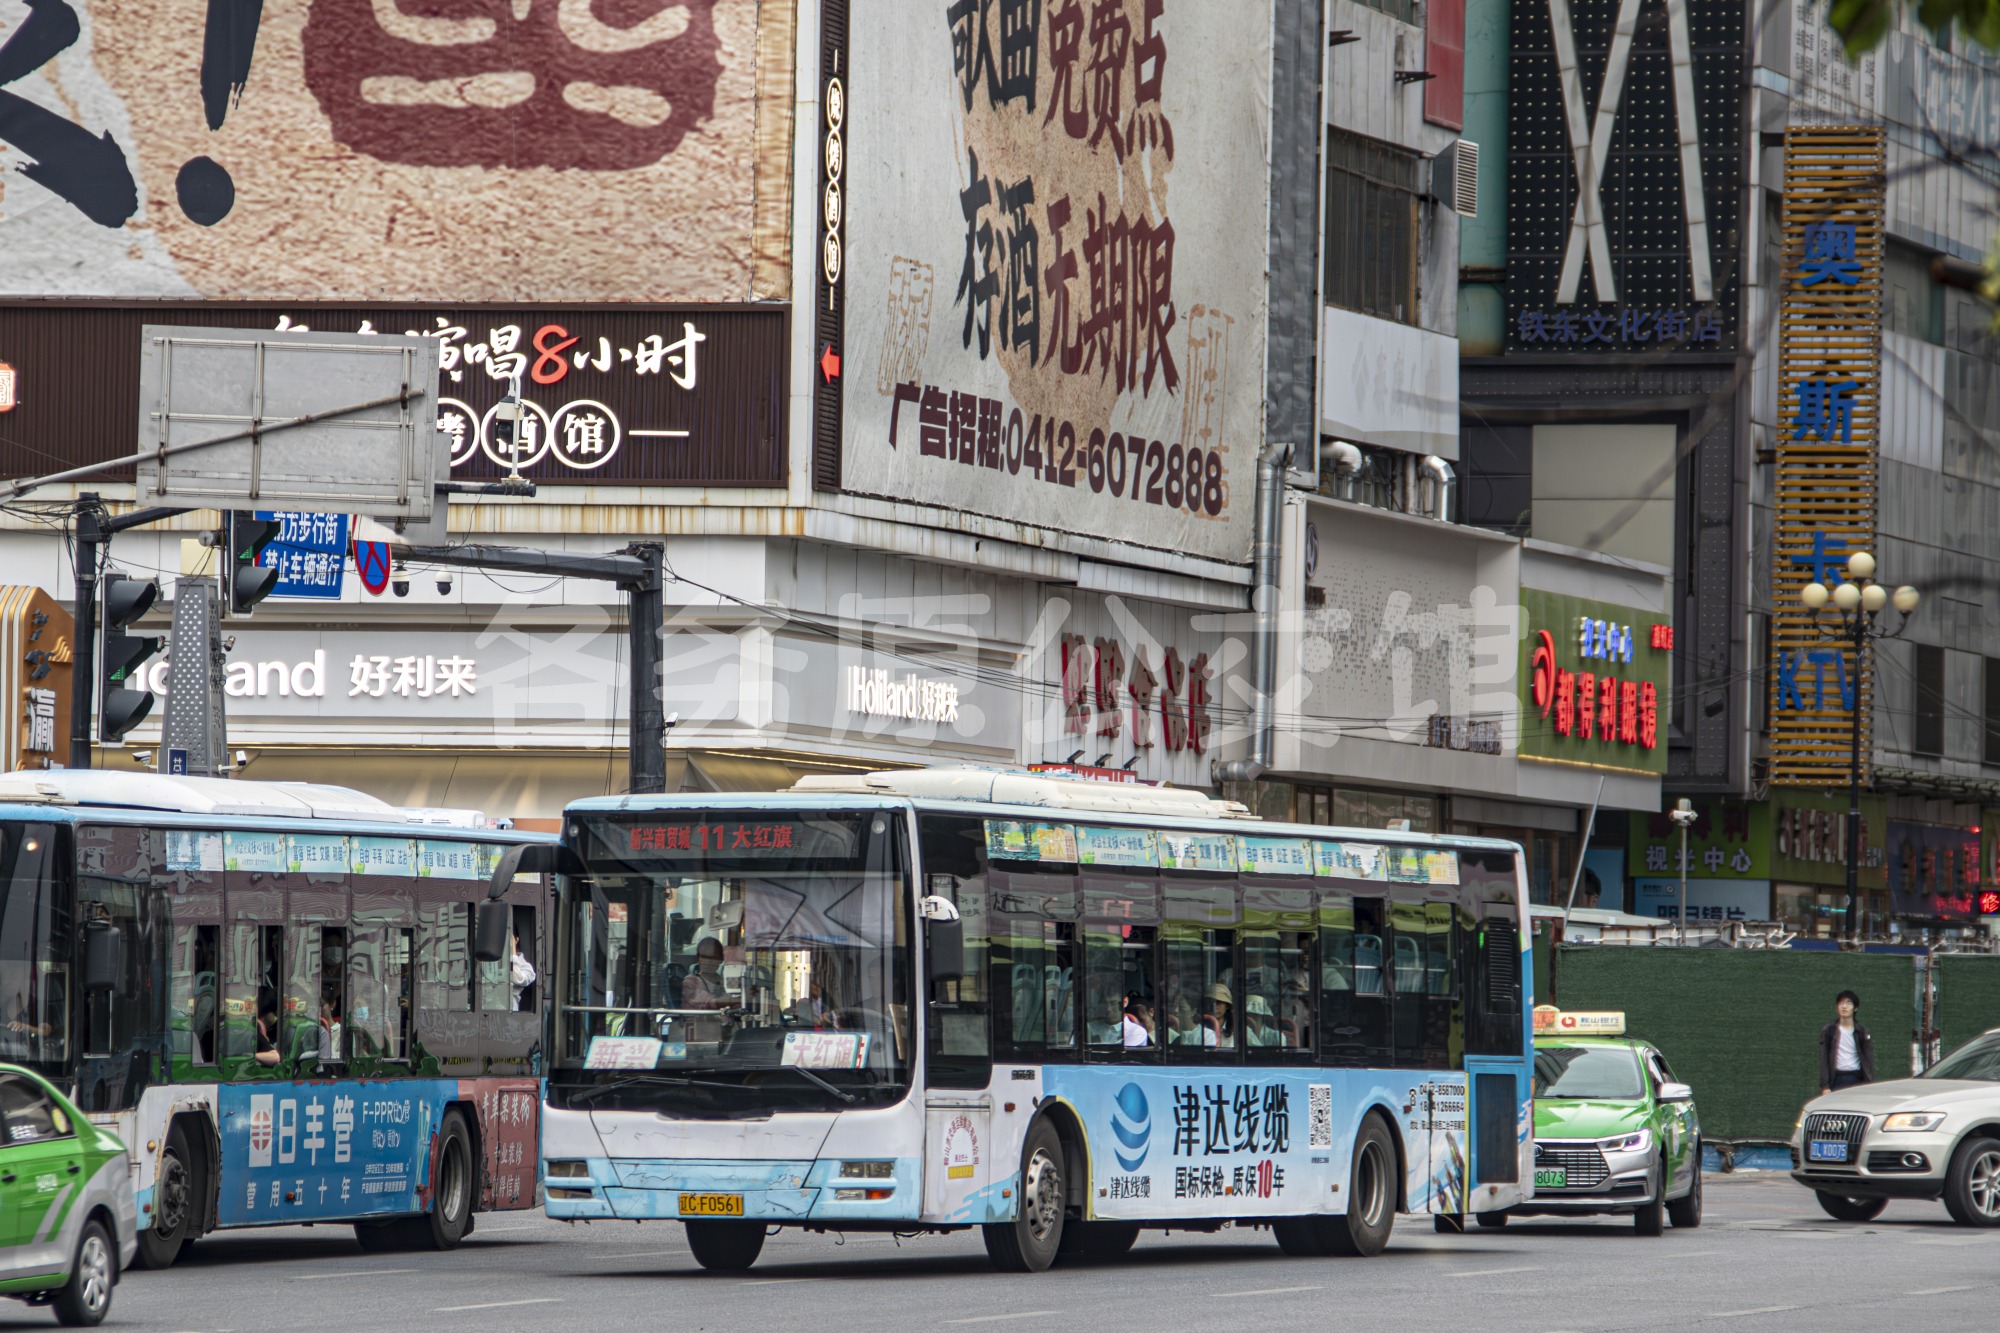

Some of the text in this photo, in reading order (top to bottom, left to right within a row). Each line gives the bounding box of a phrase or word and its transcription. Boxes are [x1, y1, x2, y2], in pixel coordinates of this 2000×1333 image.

[954, 146, 1181, 398] 存酒无期限
[1517, 308, 1724, 343] 铁东文化街店
[265, 548, 341, 587] 禁止车辆通行
[1579, 616, 1634, 664] 视光中心
[349, 654, 477, 698] 好利来
[848, 665, 959, 722] Holiland 好利来
[1779, 652, 1857, 711] KTV
[629, 825, 793, 850] 新兴商贸城 11 大红旗
[1646, 845, 1752, 874] 视光中心
[793, 1036, 855, 1068] 大红旗
[278, 1094, 354, 1167] 日丰管
[1173, 1083, 1291, 1157] 津达线缆
[1110, 1176, 1151, 1199] 津达线缆
[1174, 1159, 1285, 1199] 国标保检 质保10年
[1535, 1171, 1564, 1184] 8073
